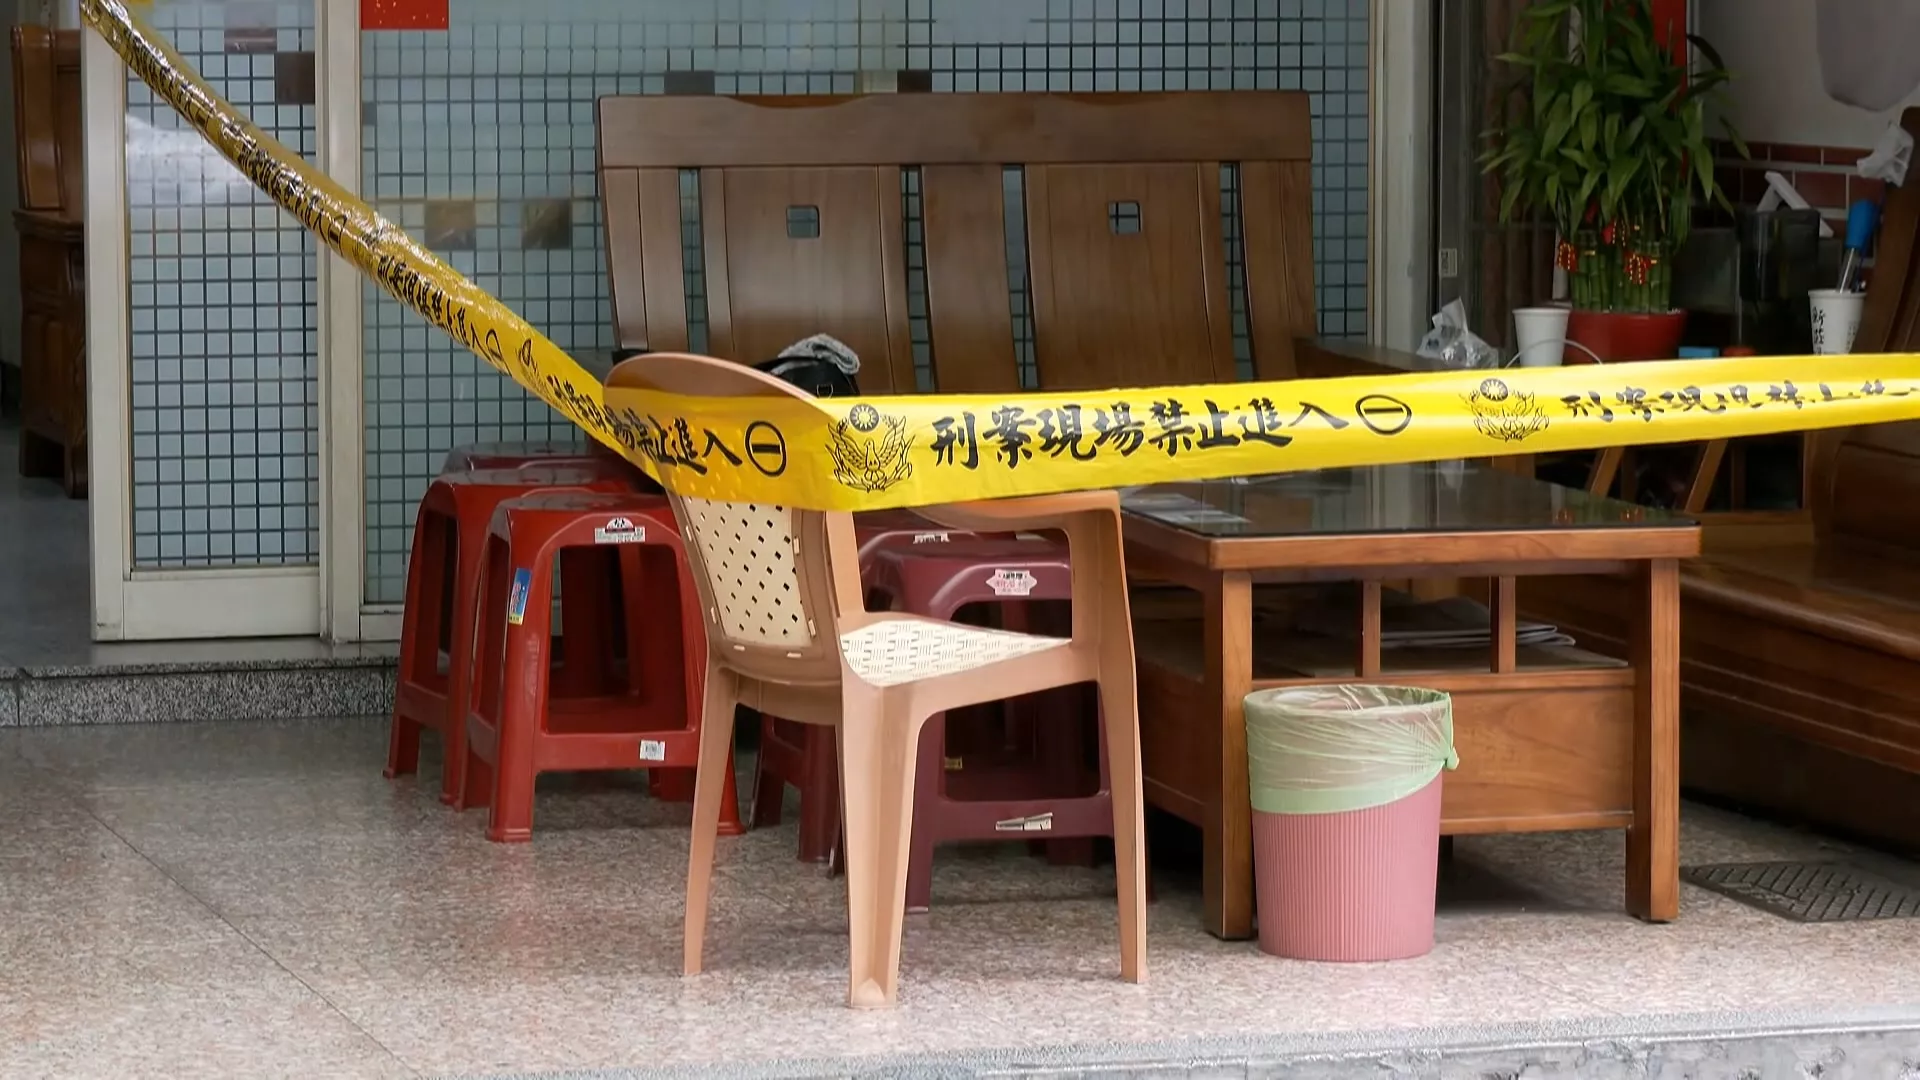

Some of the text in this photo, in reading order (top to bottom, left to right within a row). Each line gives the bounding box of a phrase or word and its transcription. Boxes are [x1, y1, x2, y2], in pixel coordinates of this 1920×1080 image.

[930, 397, 1350, 469] 刑案現場禁止進入
